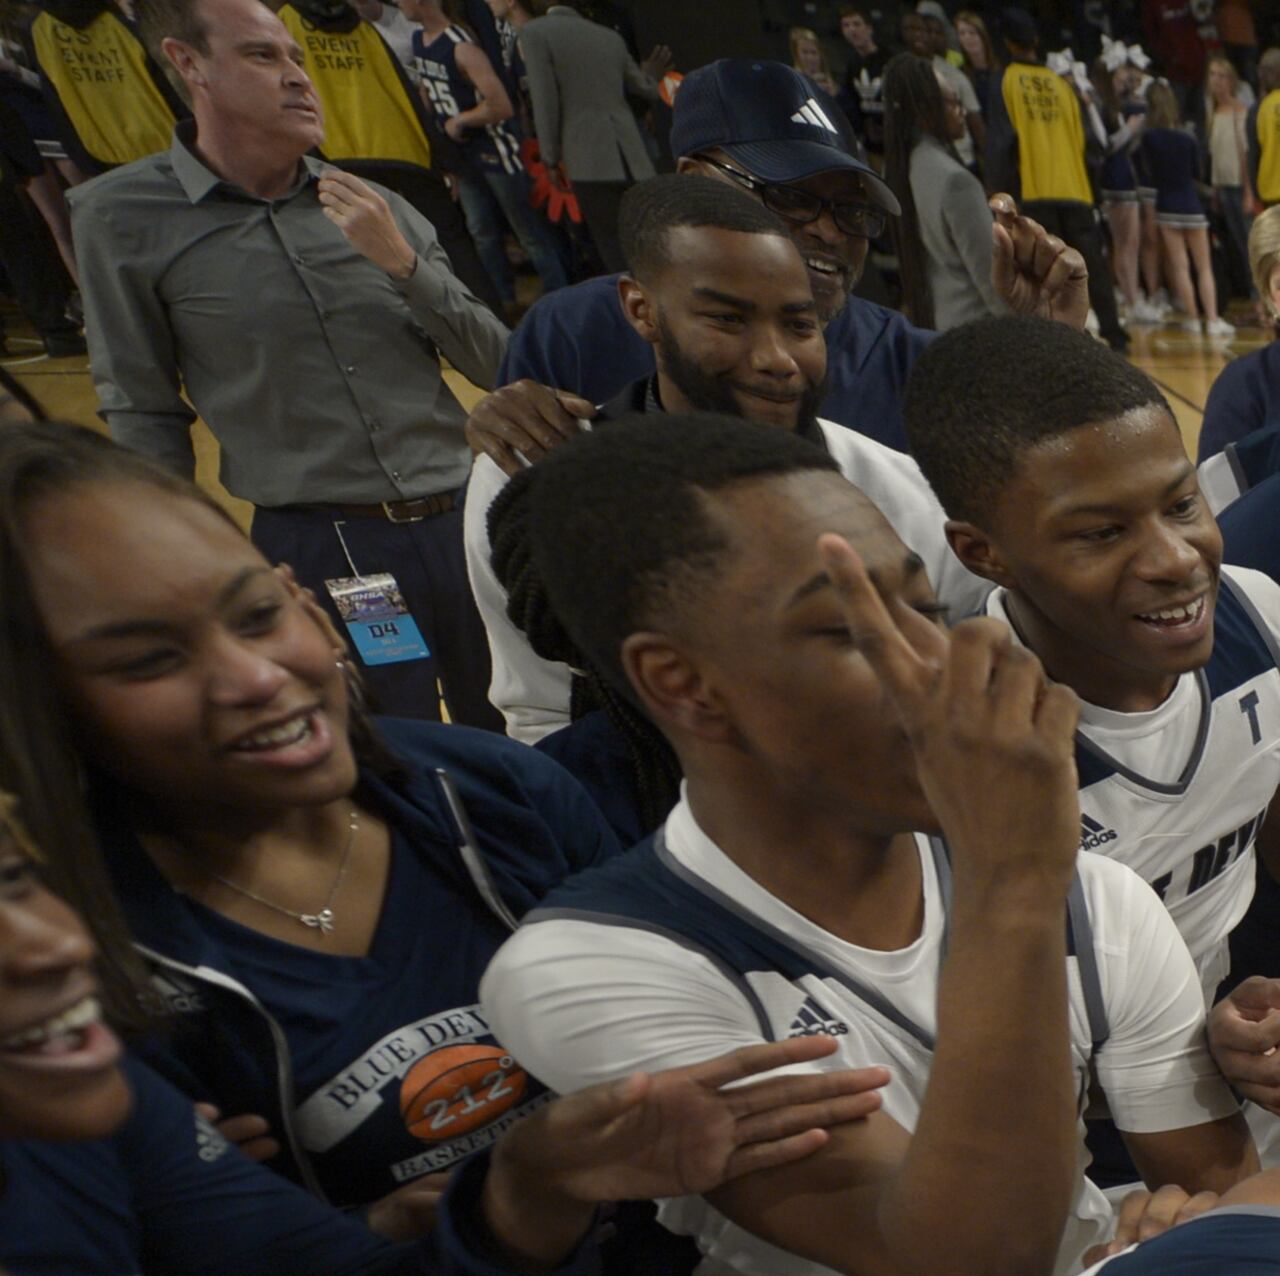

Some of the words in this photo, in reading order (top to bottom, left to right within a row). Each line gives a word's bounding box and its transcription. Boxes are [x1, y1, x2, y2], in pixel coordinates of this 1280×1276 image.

[308, 36, 361, 53] EVENT
[61, 47, 120, 65] EVENT
[314, 54, 365, 71] STAFF
[72, 67, 125, 83] STAFF
[1239, 690, 1262, 746] T
[326, 1036, 417, 1110] BLUE
